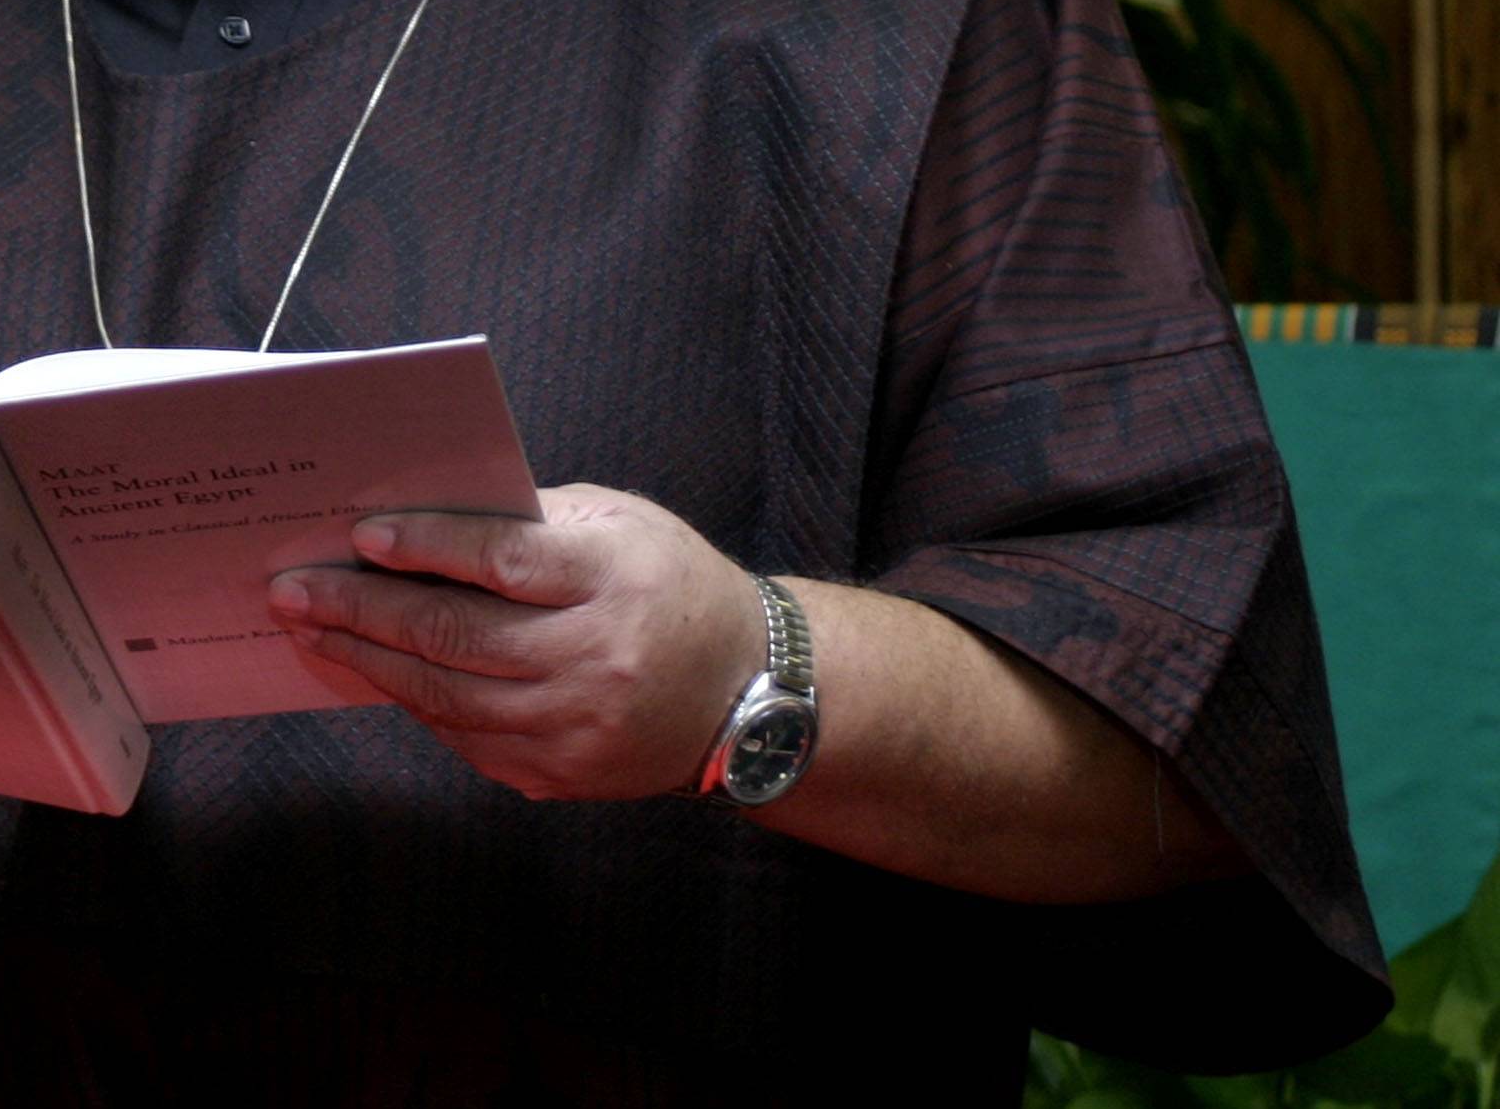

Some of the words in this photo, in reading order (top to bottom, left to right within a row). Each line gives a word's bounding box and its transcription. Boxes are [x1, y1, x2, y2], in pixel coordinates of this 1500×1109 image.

[45, 484, 100, 500] The
[111, 470, 198, 493] Moral
[210, 460, 278, 482] Ideal
[288, 457, 317, 473] in
[57, 496, 164, 519] Ancient
[174, 485, 257, 507] Egypt
[70, 534, 84, 546] A
[90, 528, 141, 544] Study
[147, 526, 166, 537] in
[171, 516, 250, 534] Classical
[257, 509, 324, 526] African
